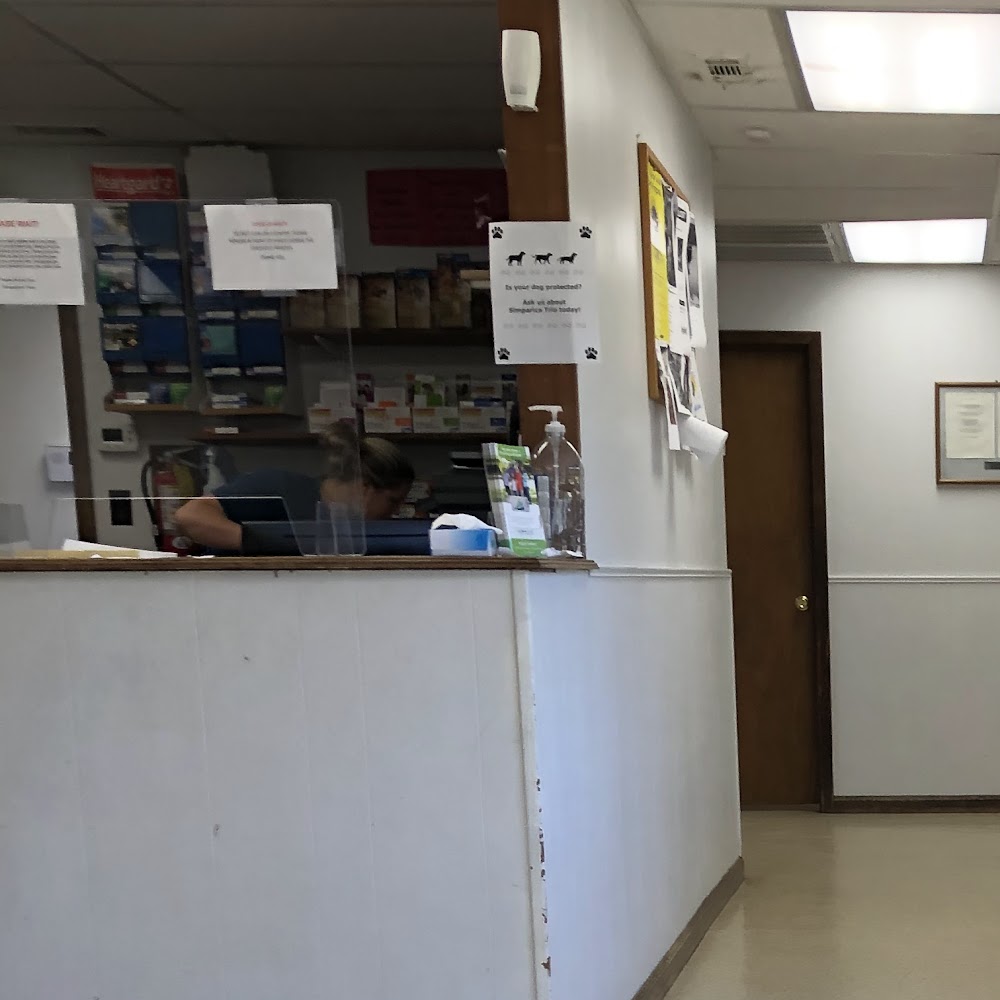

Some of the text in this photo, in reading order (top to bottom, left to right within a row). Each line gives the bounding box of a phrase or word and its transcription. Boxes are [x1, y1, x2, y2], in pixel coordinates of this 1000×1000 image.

[513, 284, 530, 292] your
[531, 283, 545, 292] dog
[545, 283, 582, 291] protected?
